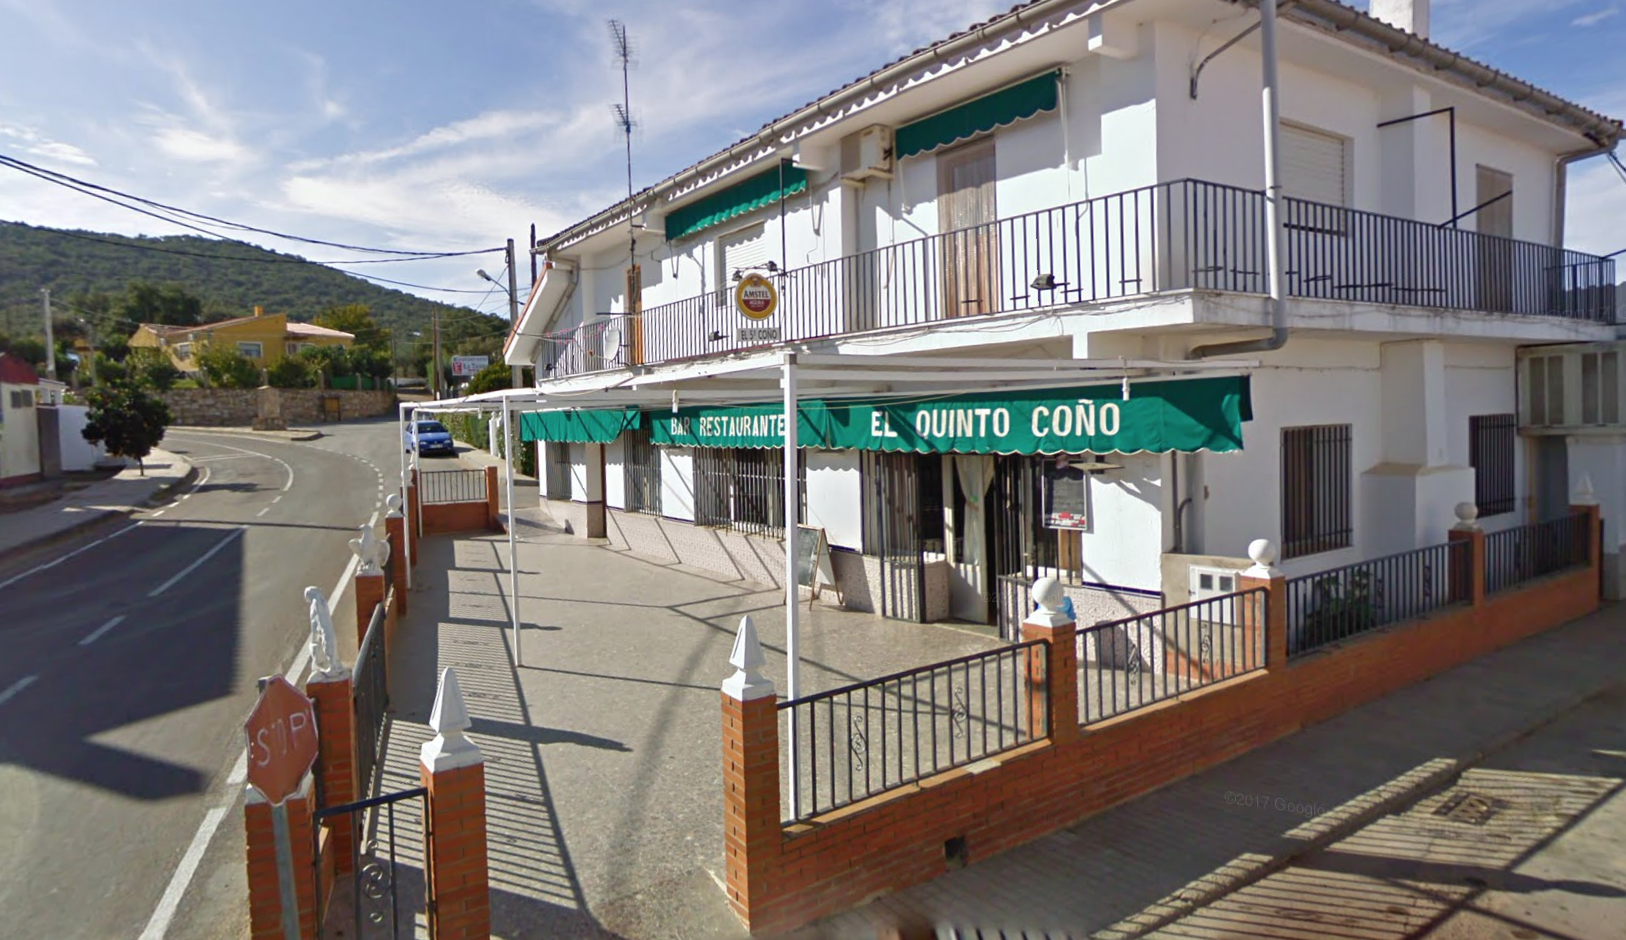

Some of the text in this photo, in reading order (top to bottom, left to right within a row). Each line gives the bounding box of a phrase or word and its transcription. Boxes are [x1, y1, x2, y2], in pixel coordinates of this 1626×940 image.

[741, 330, 748, 340] EL
[758, 328, 777, 339] COÑO
[670, 414, 785, 437] BAR RESTAURANTE
[871, 398, 1121, 440] EL QUINTO COÑO
